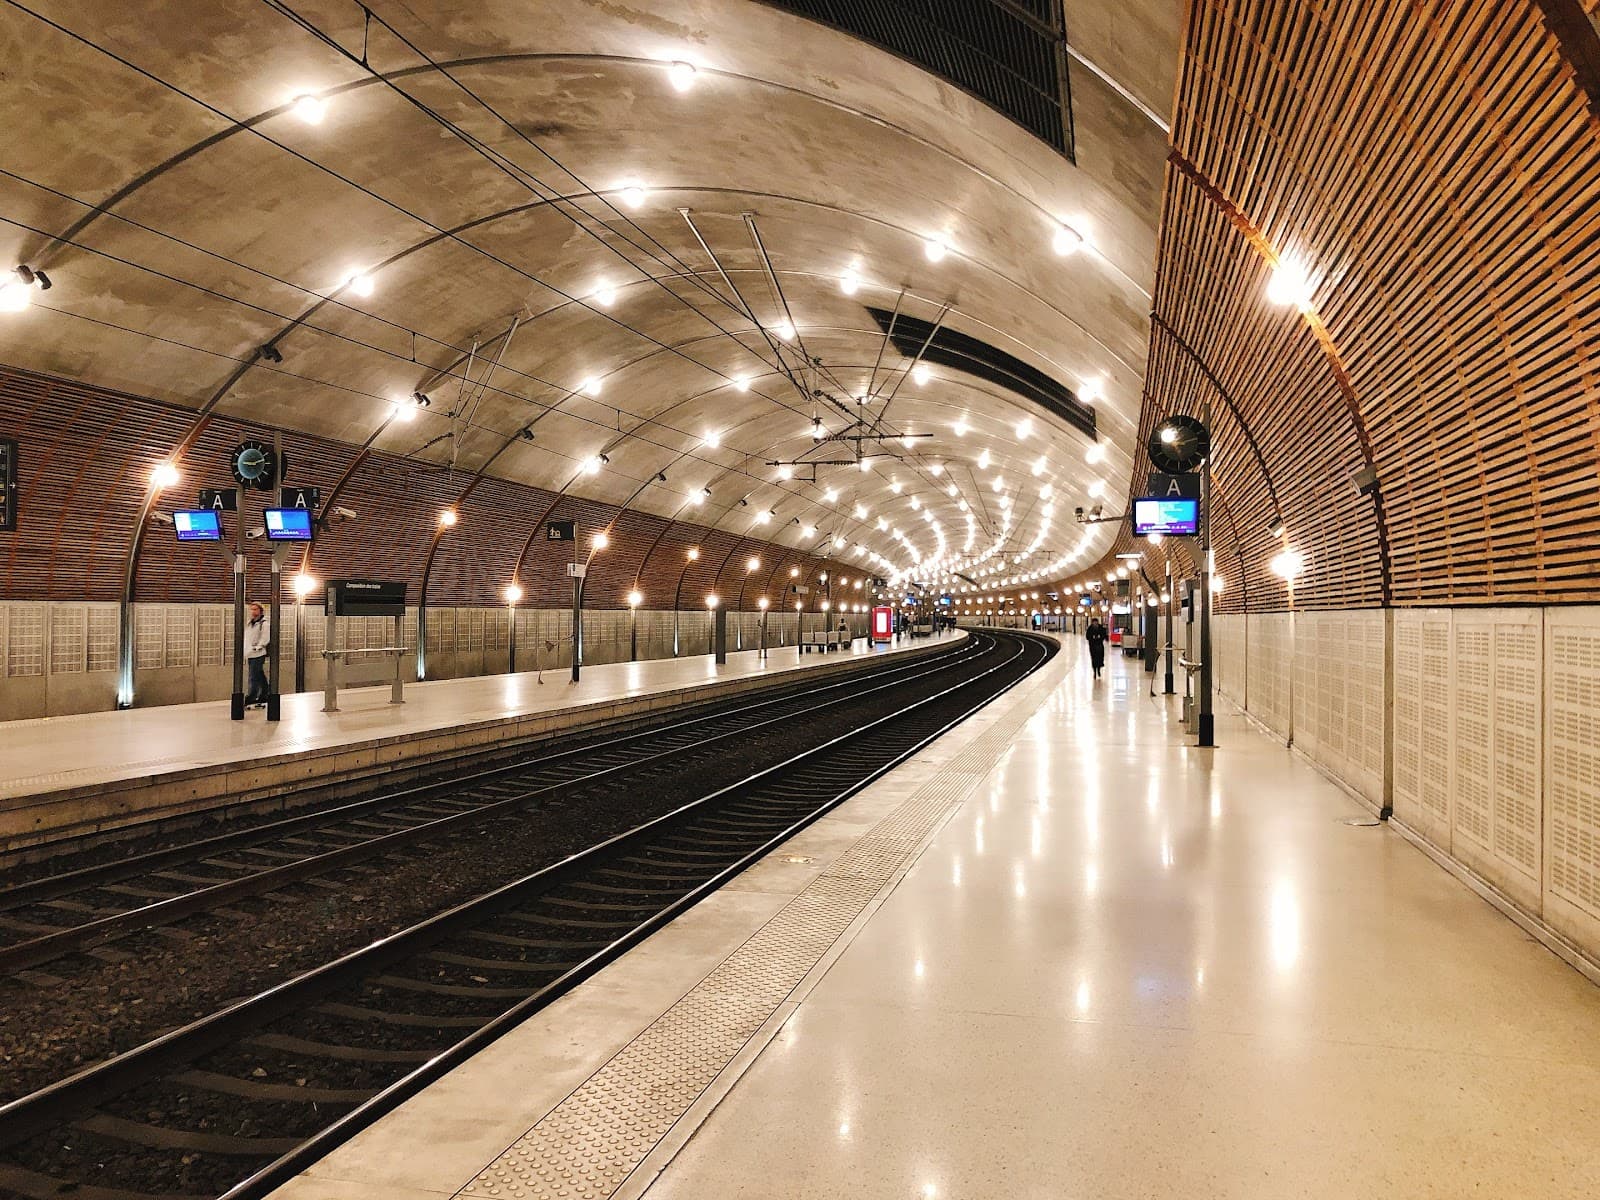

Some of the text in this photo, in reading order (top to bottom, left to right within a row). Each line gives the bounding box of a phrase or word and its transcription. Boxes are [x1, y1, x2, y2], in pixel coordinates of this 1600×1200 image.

[1166, 478, 1182, 496] A
[212, 494, 224, 509] A
[295, 492, 307, 508] A
